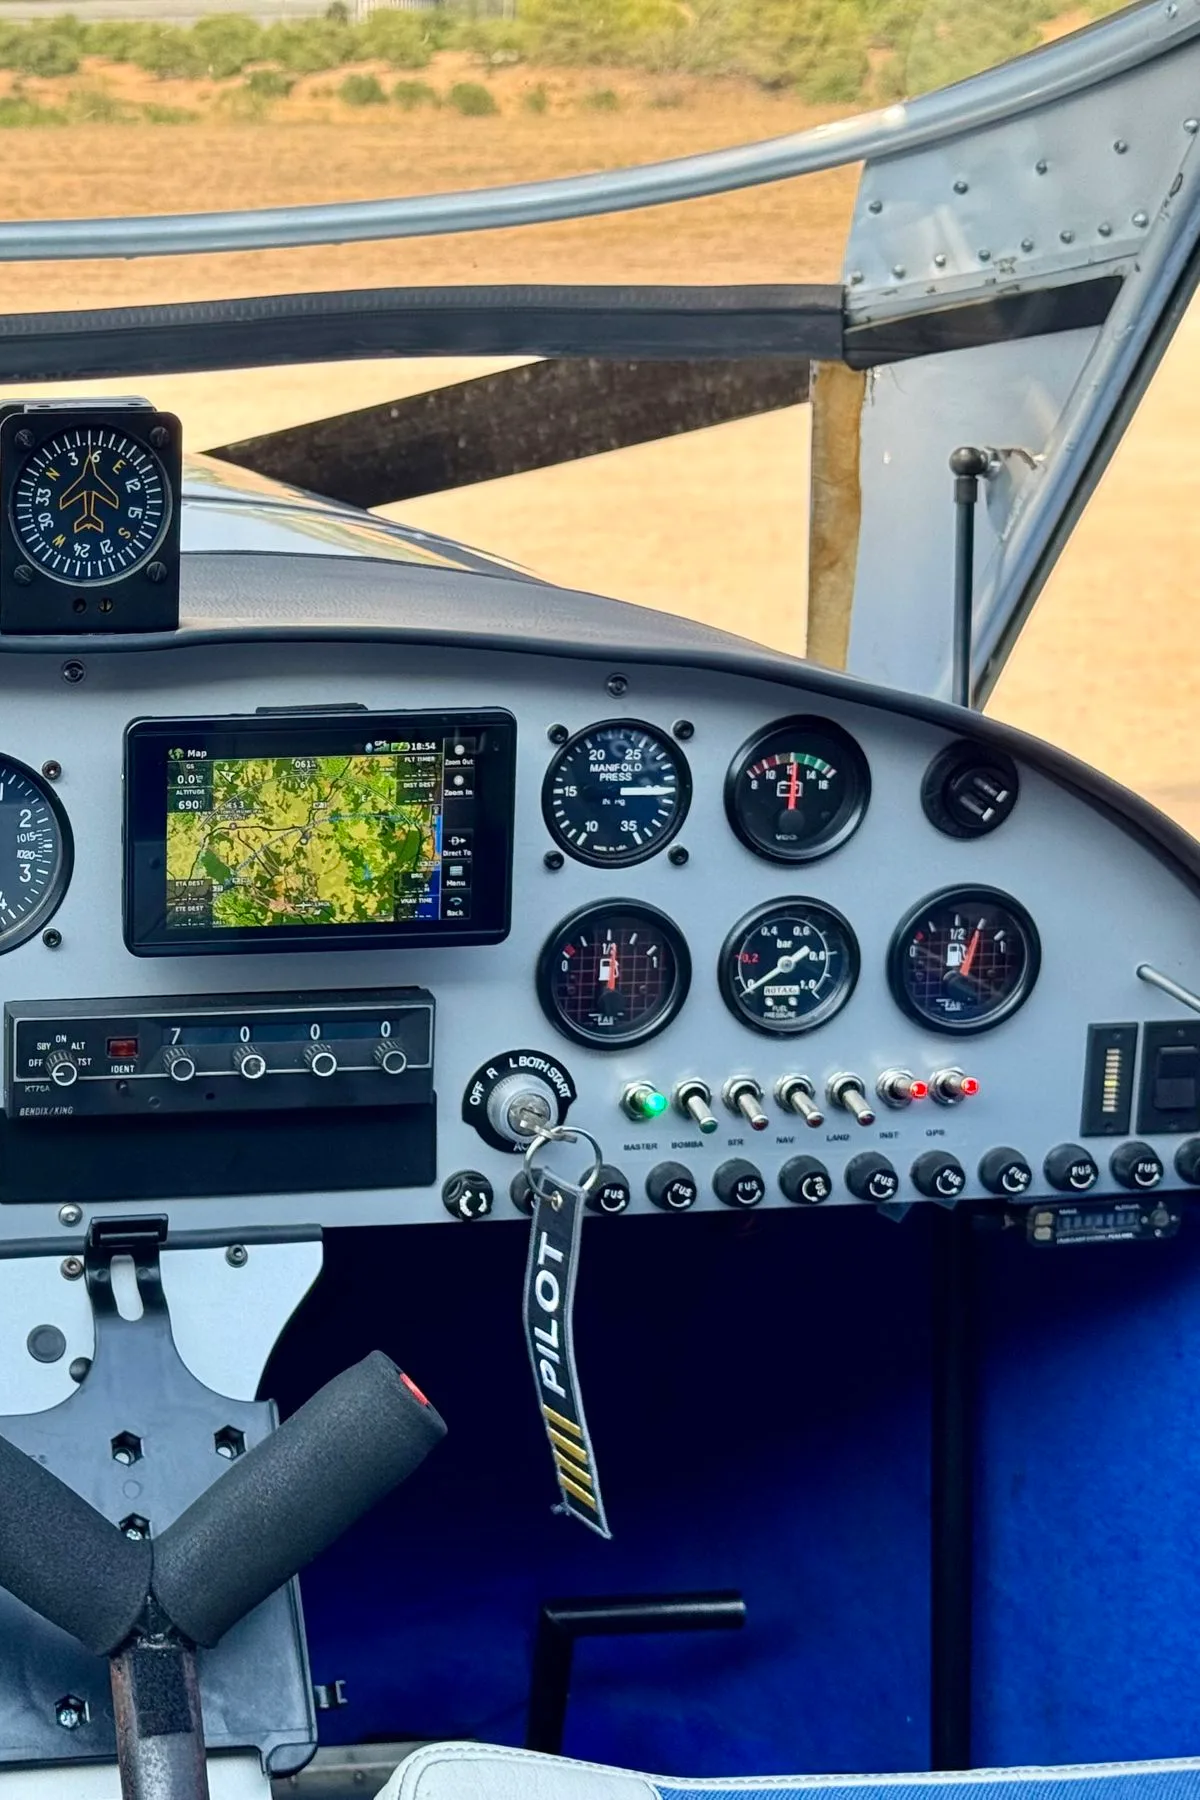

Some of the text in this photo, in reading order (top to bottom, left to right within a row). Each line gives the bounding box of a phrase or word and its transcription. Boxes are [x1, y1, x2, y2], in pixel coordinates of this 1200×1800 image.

[68, 452, 79, 466] 3
[91, 450, 102, 463] 6
[112, 459, 126, 475] E
[45, 467, 60, 481] N
[125, 479, 141, 493] 12
[36, 488, 52, 507] 33
[127, 507, 143, 519] 15
[38, 512, 54, 531] 30
[118, 527, 131, 540] S
[73, 543, 91, 558] 24
[100, 539, 114, 555] 21
[187, 750, 207, 758] Map
[589, 750, 605, 761] 20
[625, 749, 641, 760] 25
[590, 763, 642, 772] MANIFOLD
[178, 775, 195, 784] 0.0
[599, 773, 632, 781] PRESS
[766, 770, 776, 779] 10
[806, 770, 816, 779] 14
[564, 786, 577, 797] 15
[179, 801, 198, 809] 690
[19, 809, 31, 828] 2
[585, 821, 598, 831] 10
[621, 821, 637, 831] 35
[16, 832, 35, 843] 1015
[17, 850, 35, 860] 1020
[19, 864, 31, 882] 3
[761, 927, 777, 936] 0.4
[793, 926, 810, 936] 0.6
[950, 928, 965, 940] 1/2
[777, 939, 793, 948] bar
[809, 951, 825, 961] 0.8
[910, 945, 915, 957] 0
[742, 954, 759, 962] 0.2
[801, 980, 816, 989] 1.0
[170, 1021, 391, 1045] 7 0 0 0
[56, 1035, 67, 1043] ON
[28, 1059, 43, 1067] OFF
[111, 1065, 134, 1073] IDENT
[470, 1056, 571, 1105] OFF R L BOTH START
[20, 1107, 73, 1116] BENDIX/KING
[776, 1136, 794, 1144] NAV
[827, 1134, 850, 1142] LAND
[880, 1131, 899, 1139] INST
[671, 1140, 703, 1148] BOMBA
[1072, 1165, 1091, 1176] FUS
[1138, 1163, 1157, 1172] FUS
[874, 1174, 893, 1186] FUS
[942, 1169, 961, 1185] FUS
[1008, 1167, 1028, 1184] FUS
[672, 1183, 692, 1198] FUS
[738, 1181, 758, 1192] FUS
[604, 1189, 624, 1199] FUS
[534, 1232, 567, 1398] PILOT
